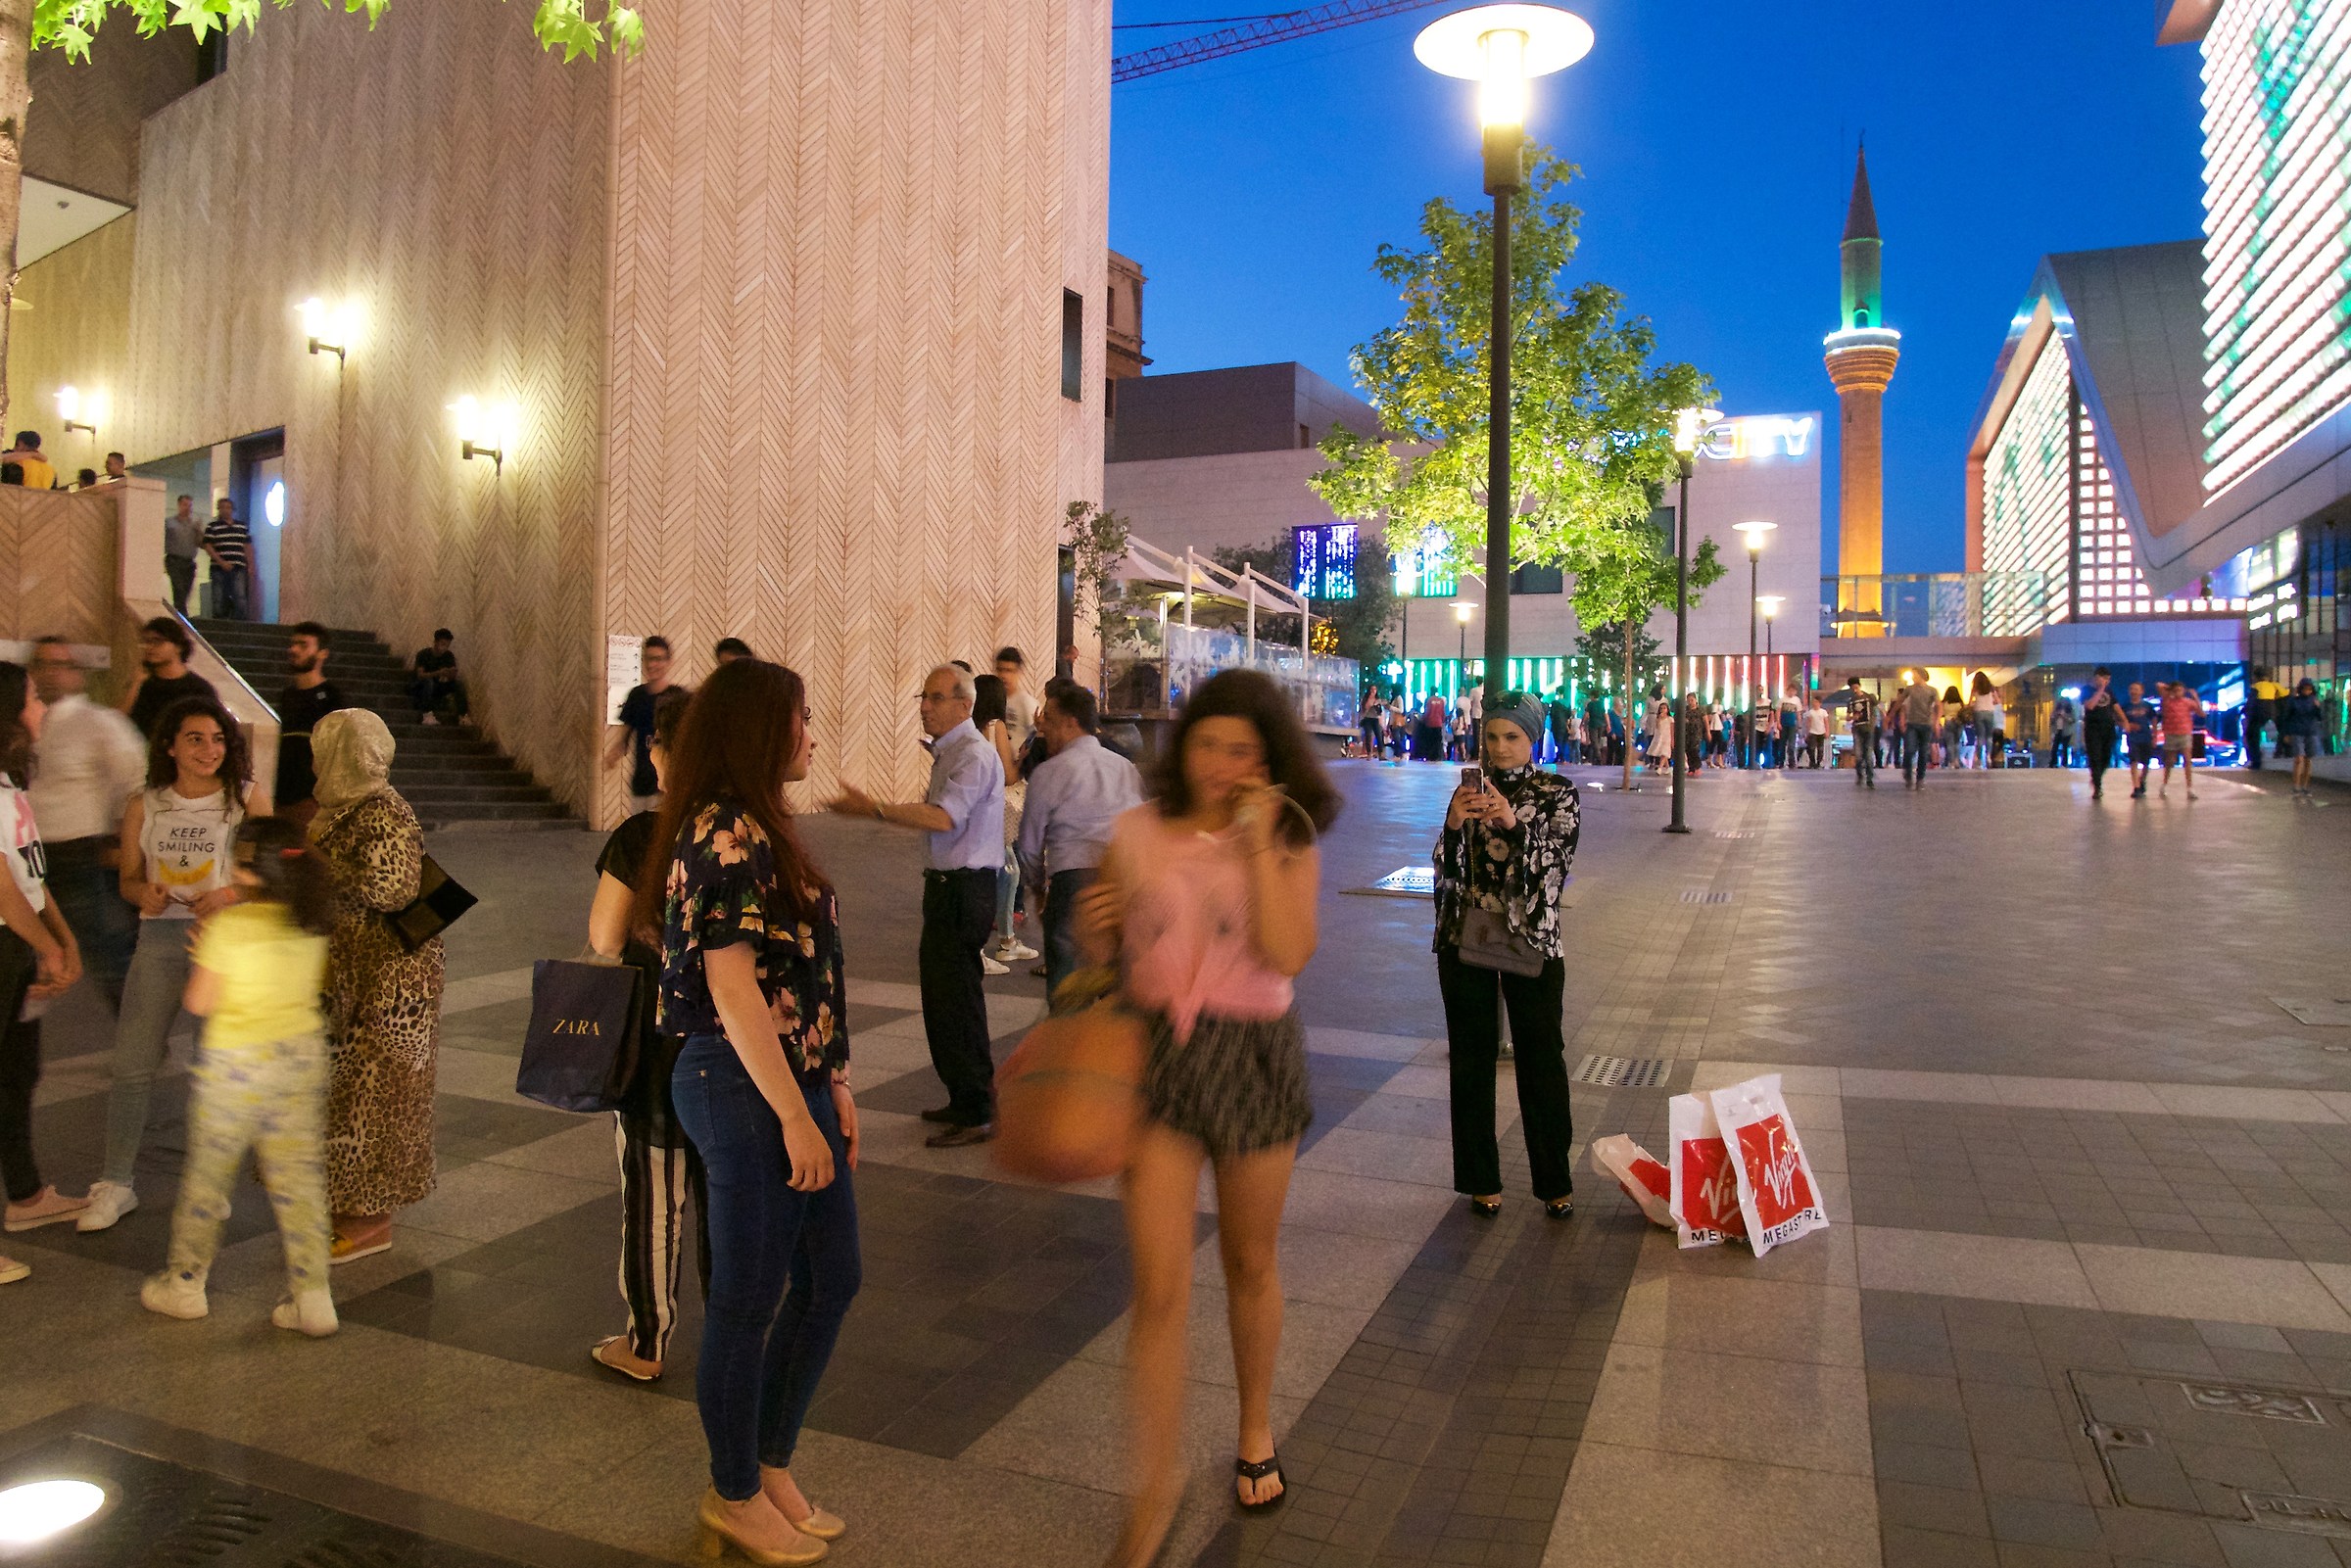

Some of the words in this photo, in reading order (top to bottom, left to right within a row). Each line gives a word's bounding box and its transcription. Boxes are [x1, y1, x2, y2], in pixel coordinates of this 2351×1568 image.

[169, 828, 208, 838] KEEP
[158, 841, 216, 853] SMILING
[179, 855, 189, 867] &
[552, 1019, 600, 1036] ZARA
